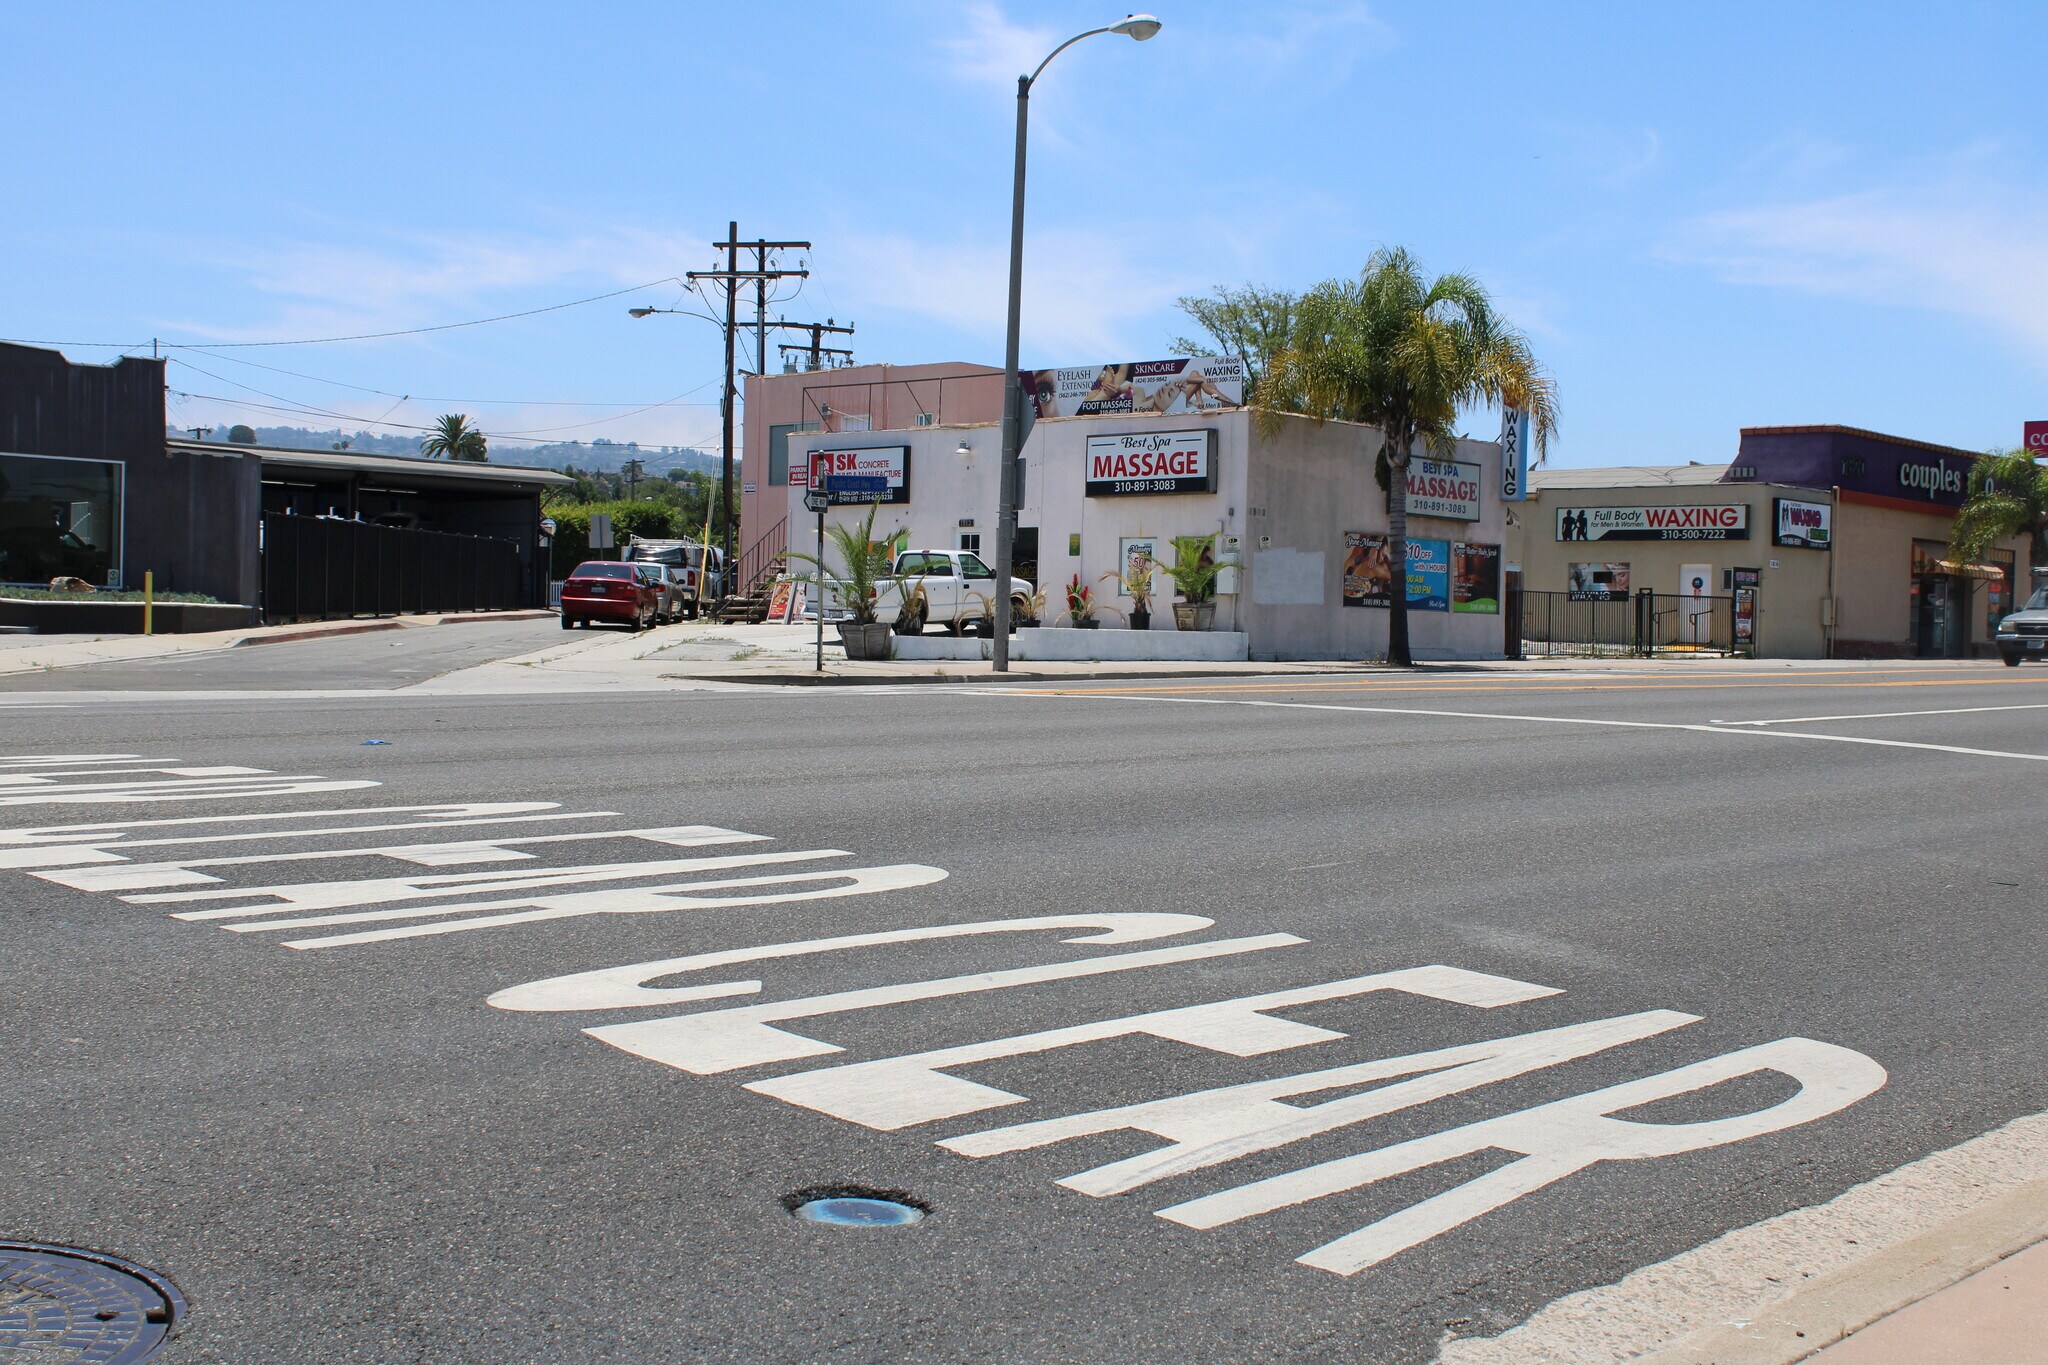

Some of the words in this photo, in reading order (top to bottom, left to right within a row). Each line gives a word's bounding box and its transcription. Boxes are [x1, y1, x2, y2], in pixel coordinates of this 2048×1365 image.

[1225, 356, 1240, 364] Body
[1204, 365, 1240, 376] WAXING
[1082, 402, 1100, 410] FOOT
[1101, 400, 1132, 409] MASSAGE
[1120, 436, 1146, 448] Best
[1148, 435, 1171, 451] Spa
[1504, 411, 1520, 496] WAXING
[836, 454, 858, 470] SK
[858, 460, 890, 468] CONCRETE
[1093, 450, 1198, 478] MASSAGE
[1423, 462, 1441, 475] BEST
[1444, 465, 1458, 478] SPA
[1114, 480, 1176, 492] 310-891-3083
[1901, 459, 1961, 499] couples
[1406, 474, 1478, 502] MASSAGE
[1414, 500, 1466, 514] 310-891-3083
[1594, 510, 1612, 520] Full
[1614, 510, 1641, 522] Body
[1645, 508, 1738, 527] WAXING
[1662, 530, 1726, 539] 310-500-7222
[1012, 566, 1037, 578] ASSAGE
[1429, 563, 1447, 573] HOURS
[486, 911, 1888, 1277] CLEAR
